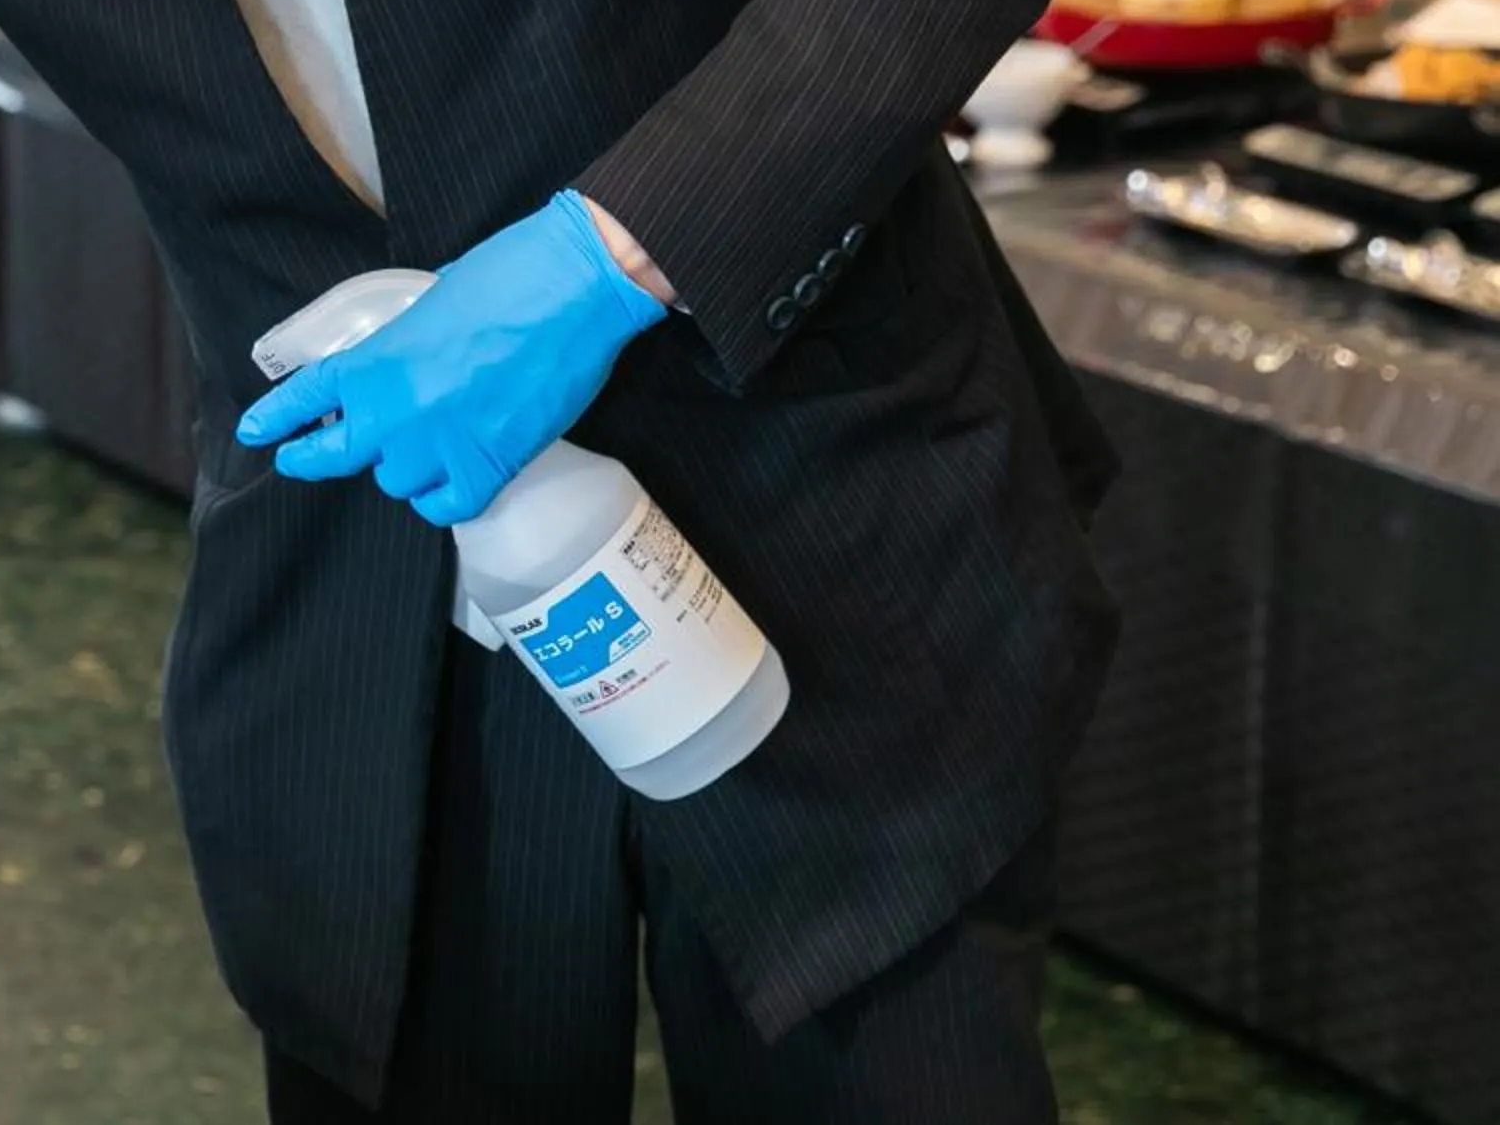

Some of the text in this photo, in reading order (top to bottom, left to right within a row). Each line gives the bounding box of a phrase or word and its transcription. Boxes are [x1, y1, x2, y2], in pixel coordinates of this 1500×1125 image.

[533, 616, 605, 662] エコラール
